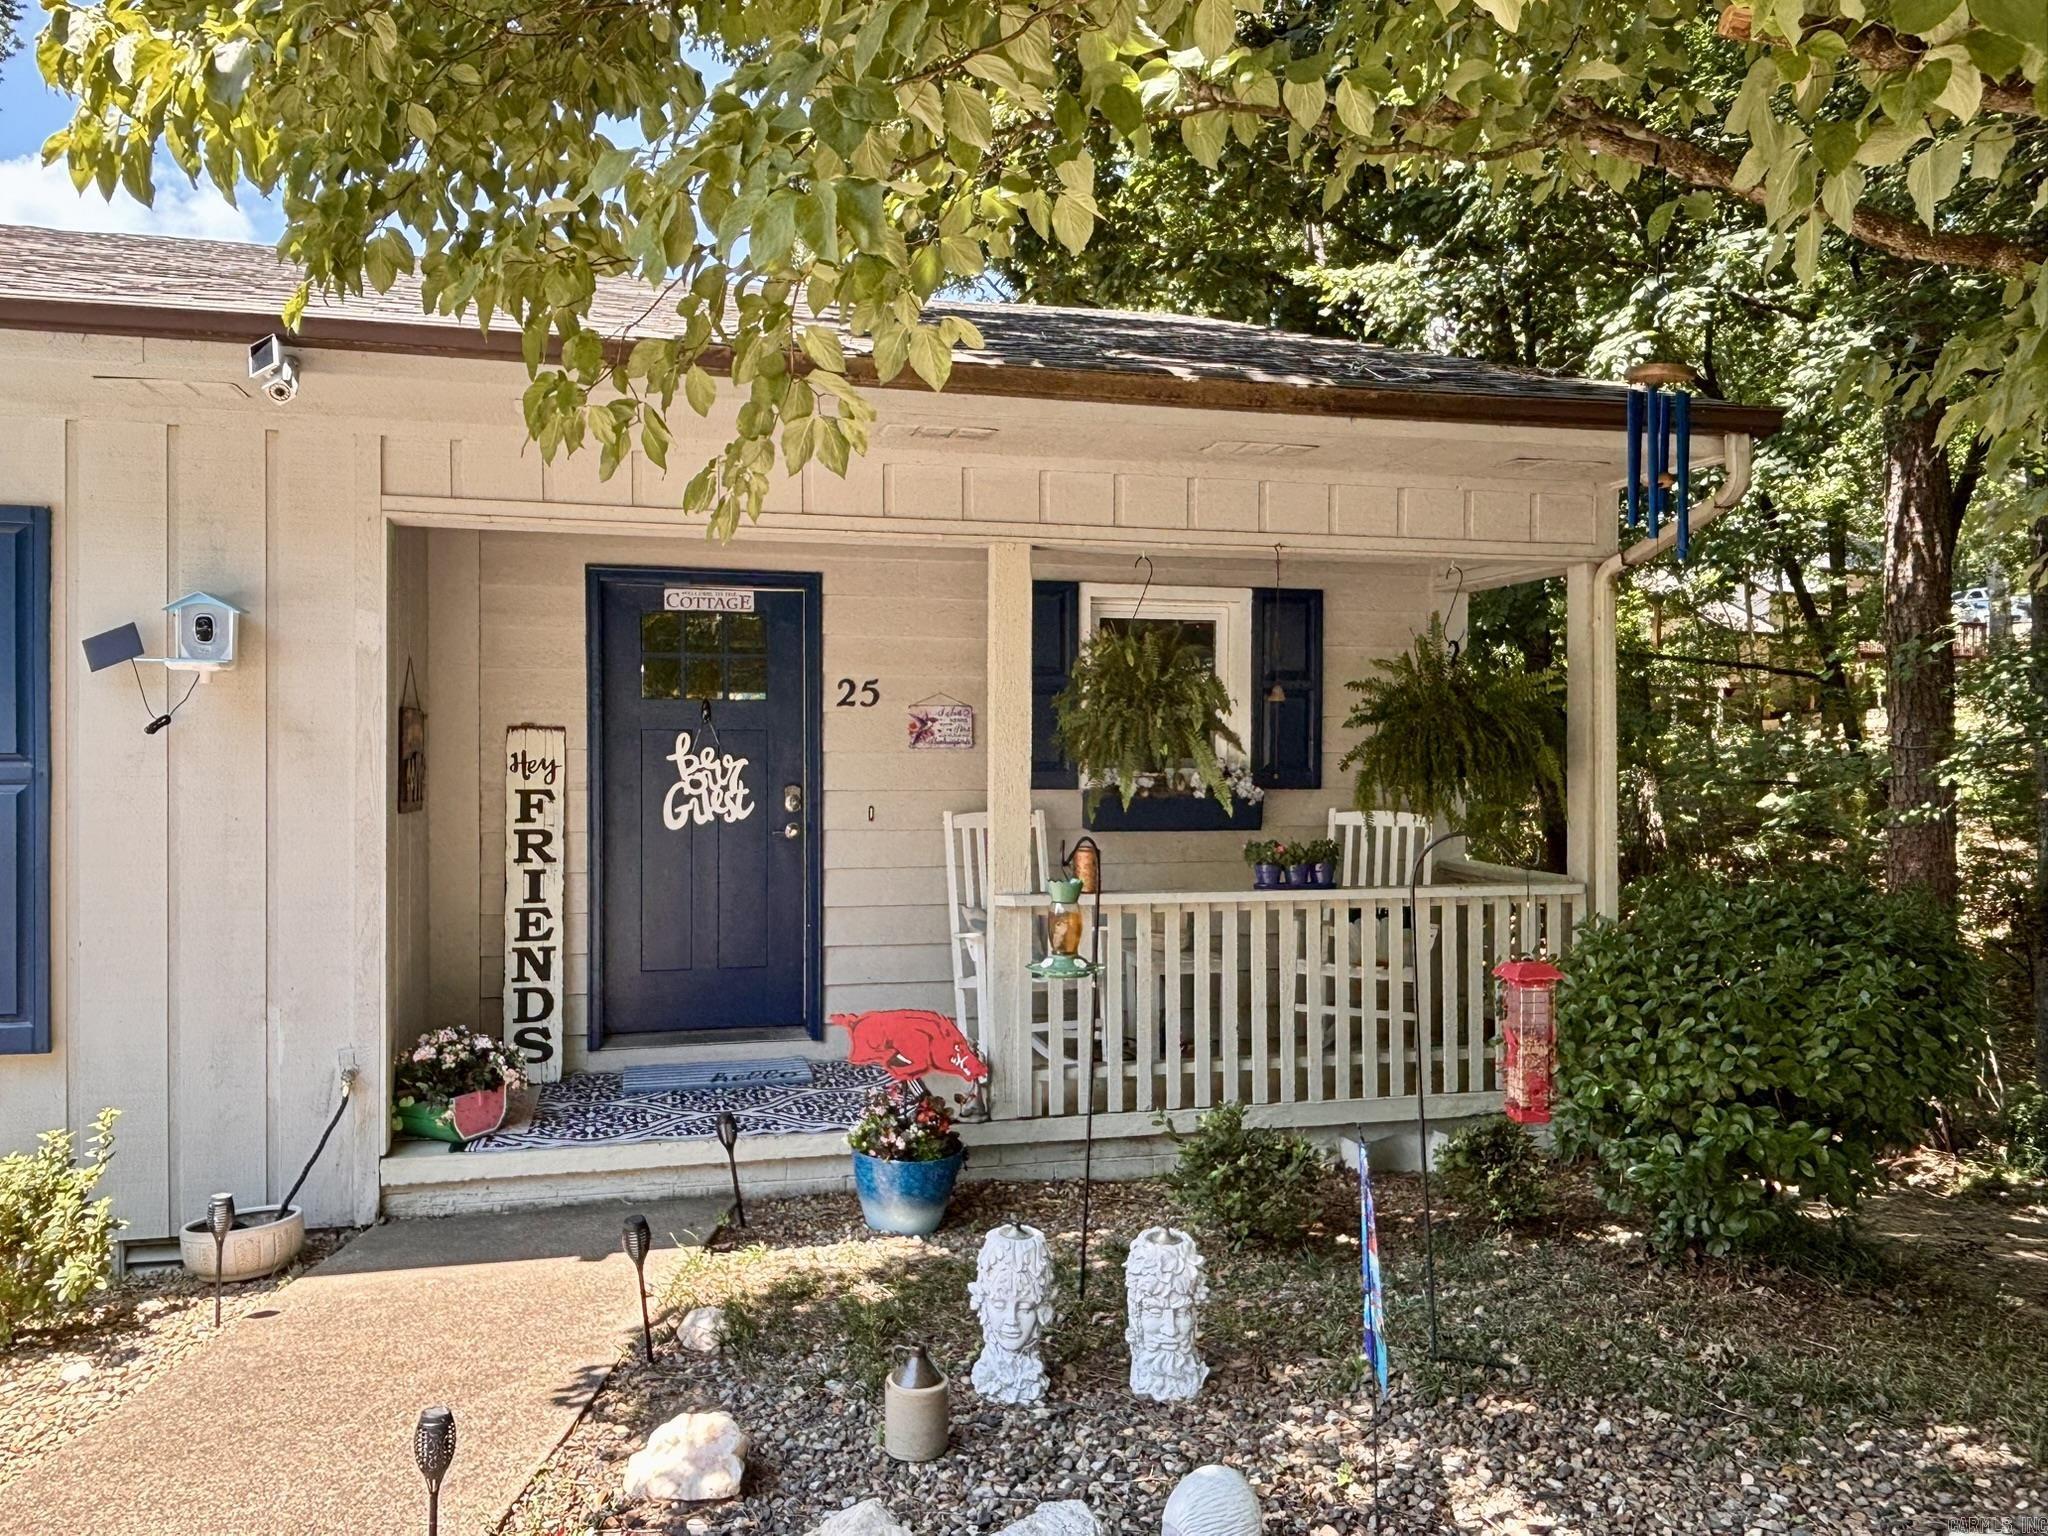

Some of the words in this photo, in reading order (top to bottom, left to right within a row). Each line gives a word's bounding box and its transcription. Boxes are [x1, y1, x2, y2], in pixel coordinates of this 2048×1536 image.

[666, 592, 752, 610] COTTAGE
[836, 678, 880, 707] 25
[510, 749, 562, 785] Hey
[663, 780, 755, 830] Guest
[512, 788, 557, 1064] FRIENDS
[711, 1069, 797, 1082] hello
